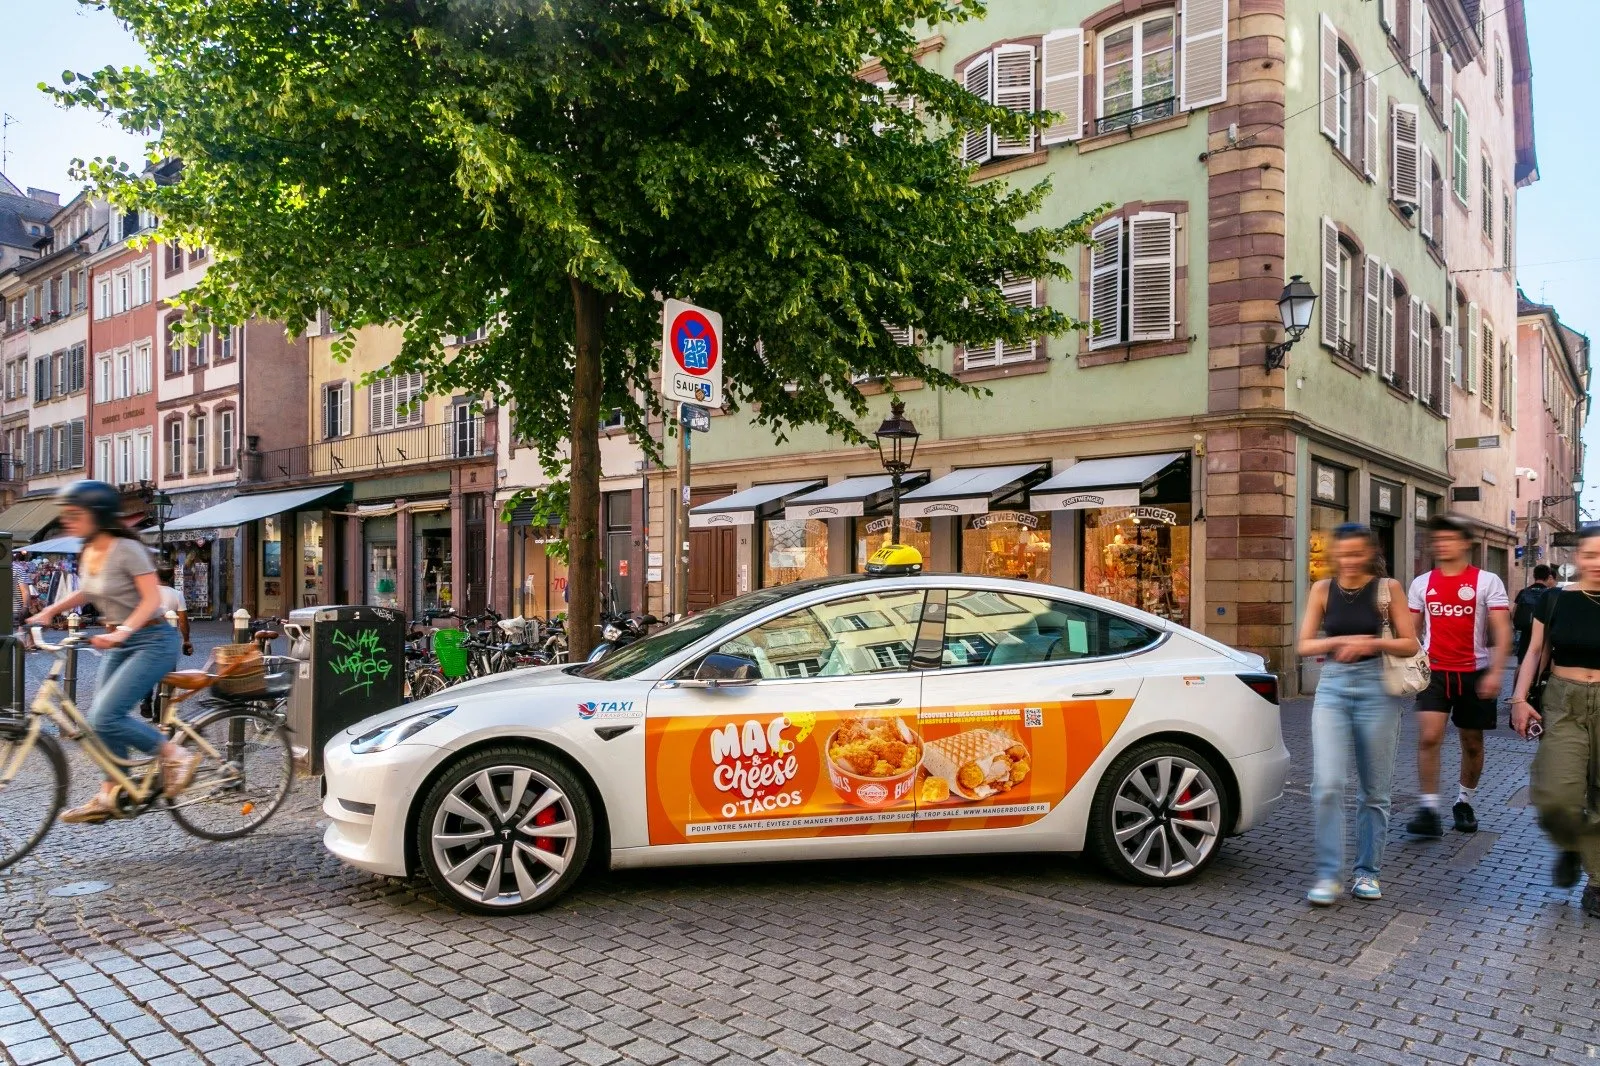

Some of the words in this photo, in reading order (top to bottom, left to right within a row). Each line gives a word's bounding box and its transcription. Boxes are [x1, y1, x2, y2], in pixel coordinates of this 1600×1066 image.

[1062, 495, 1105, 507] FORTWENGER
[973, 511, 1039, 529] FORTWENGER
[875, 549, 894, 560] TAXI
[601, 701, 634, 712] TAXI
[710, 717, 795, 765] MAC
[713, 755, 798, 798] Cheese
[721, 790, 802, 818] O'TACOS
[691, 825, 711, 833] POUR
[713, 823, 736, 832] VOTRE
[738, 821, 764, 830] SANTÉ,
[766, 819, 790, 829] ÉVITEZ
[804, 816, 834, 825] MANGER
[835, 815, 853, 823] TROP
[878, 813, 895, 821] TROP
[963, 805, 1045, 816] WWW.MANGERBOUGER.FR
